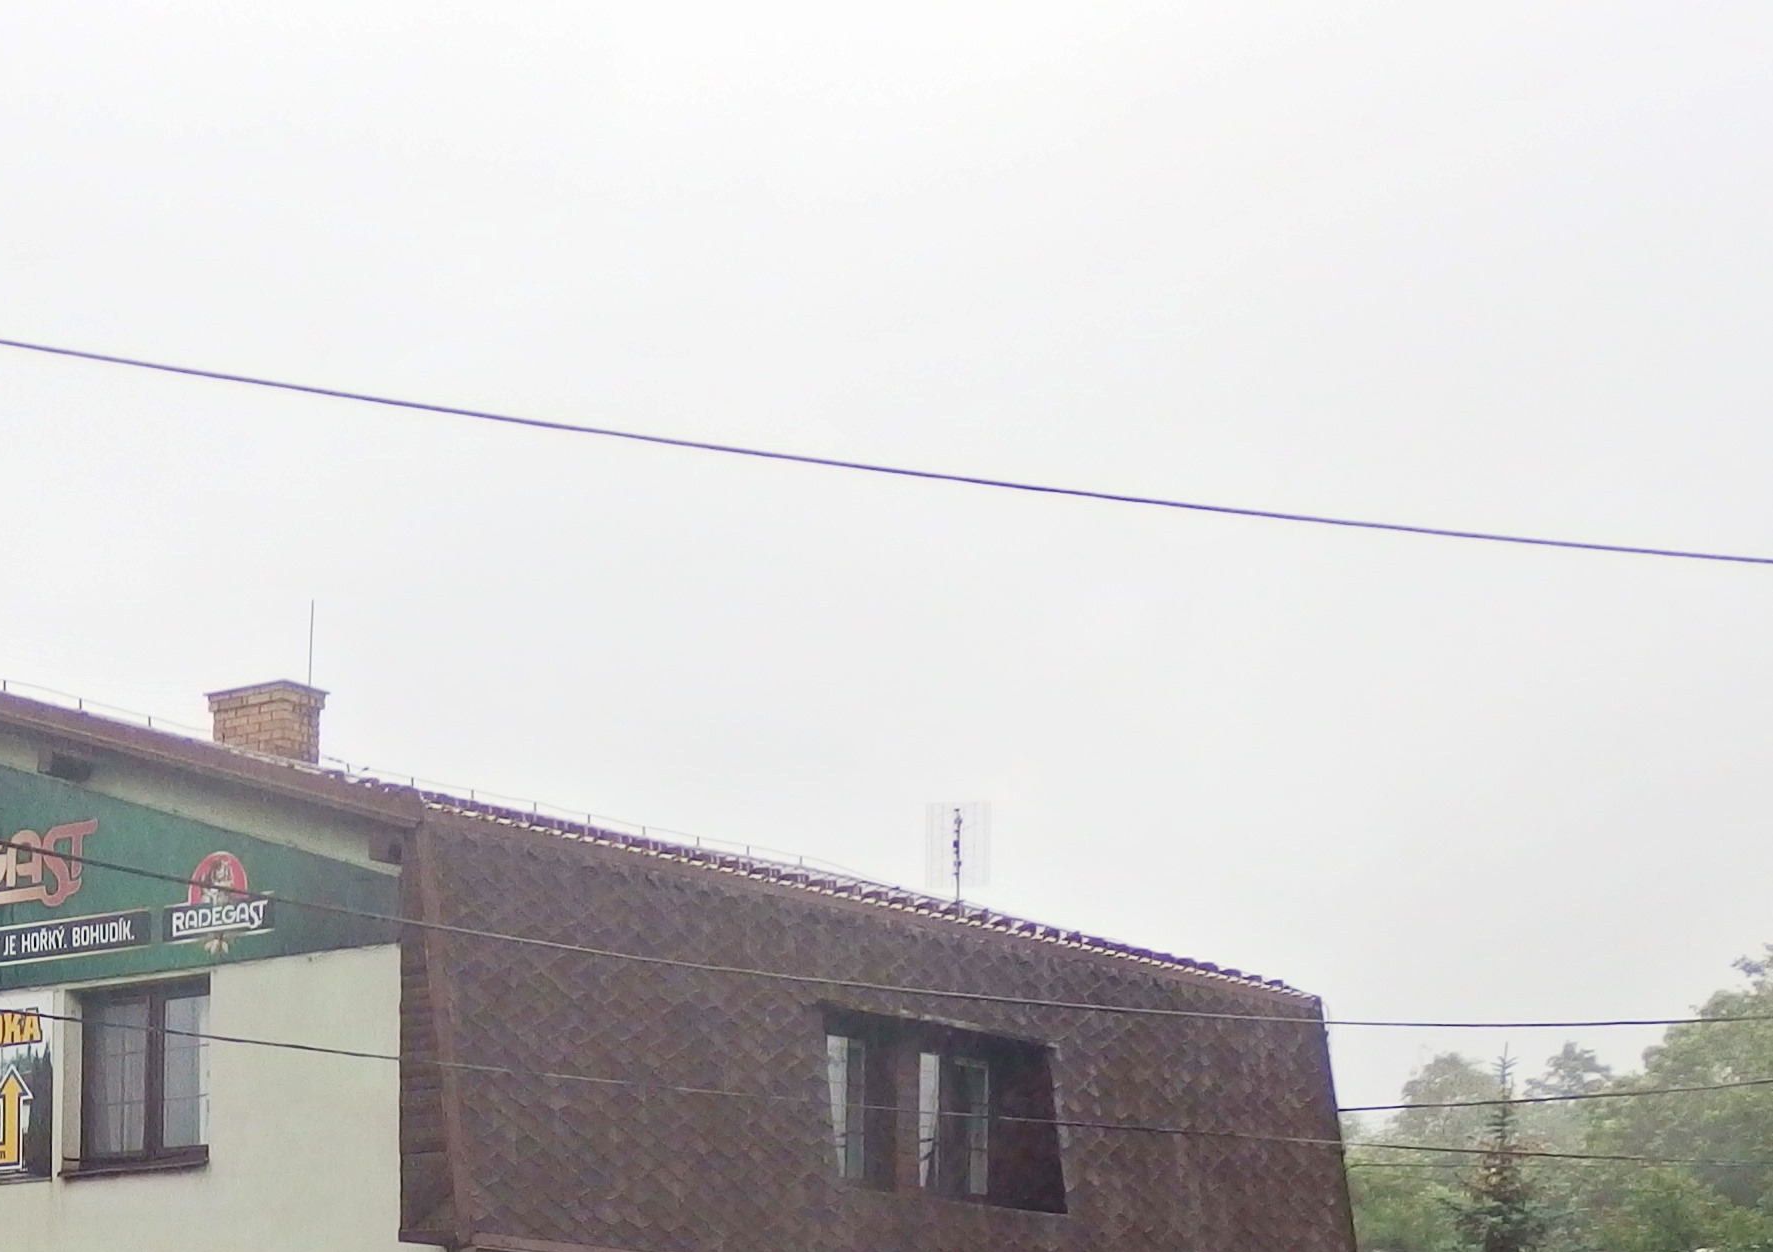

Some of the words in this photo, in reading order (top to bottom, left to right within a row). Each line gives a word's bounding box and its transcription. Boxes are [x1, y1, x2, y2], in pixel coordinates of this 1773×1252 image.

[3, 935, 16, 956] JE
[21, 926, 67, 953] HOŘKÝ.
[72, 917, 135, 947] BOHUDÍK.
[171, 900, 268, 937] RADEGAST
